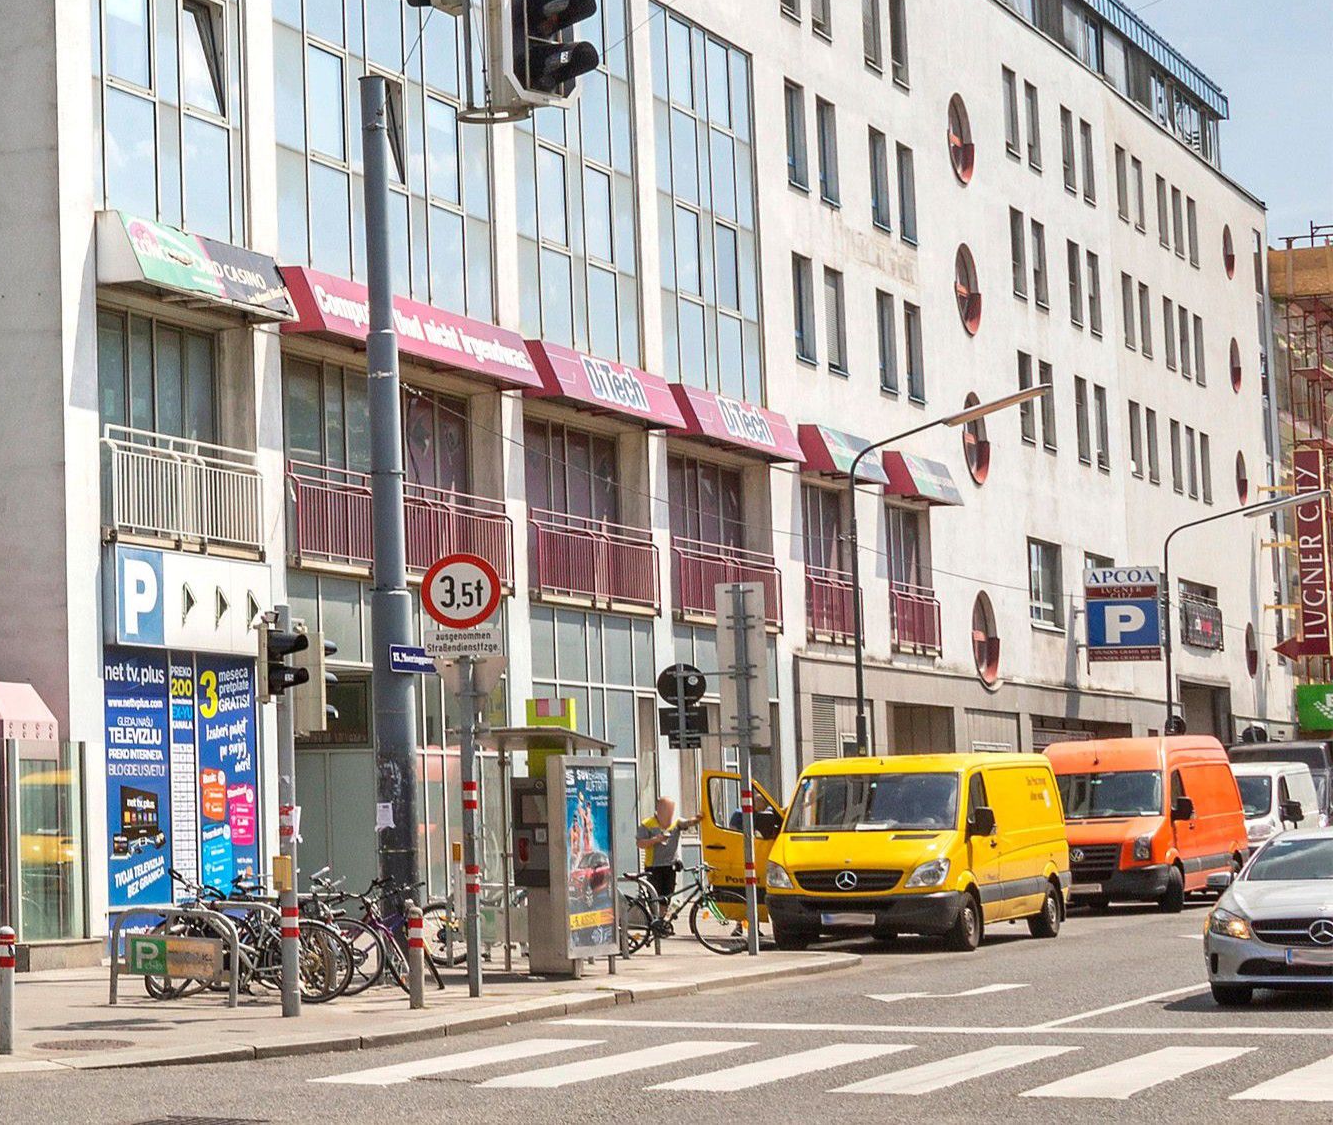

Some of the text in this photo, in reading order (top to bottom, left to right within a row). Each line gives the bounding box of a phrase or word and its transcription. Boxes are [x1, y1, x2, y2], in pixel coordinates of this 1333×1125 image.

[224, 263, 267, 291] CASINO
[582, 356, 650, 412] DiTech
[716, 396, 775, 446] DiTech
[1295, 466, 1327, 639] LUGNER CTY
[1088, 569, 1155, 584] APCOA
[123, 557, 158, 635] P
[439, 575, 484, 610] 3,5t
[1101, 586, 1142, 594] LUGNER
[1104, 605, 1146, 644] P
[435, 632, 491, 643] ausgenommen
[105, 663, 165, 686] net tv.plus
[171, 666, 193, 677] PREKO
[218, 667, 248, 682] meseca
[171, 679, 193, 696] 200
[199, 670, 219, 719] 3
[219, 679, 249, 696] pretplate
[219, 694, 250, 713] GRATIS!
[136, 941, 159, 970] P
